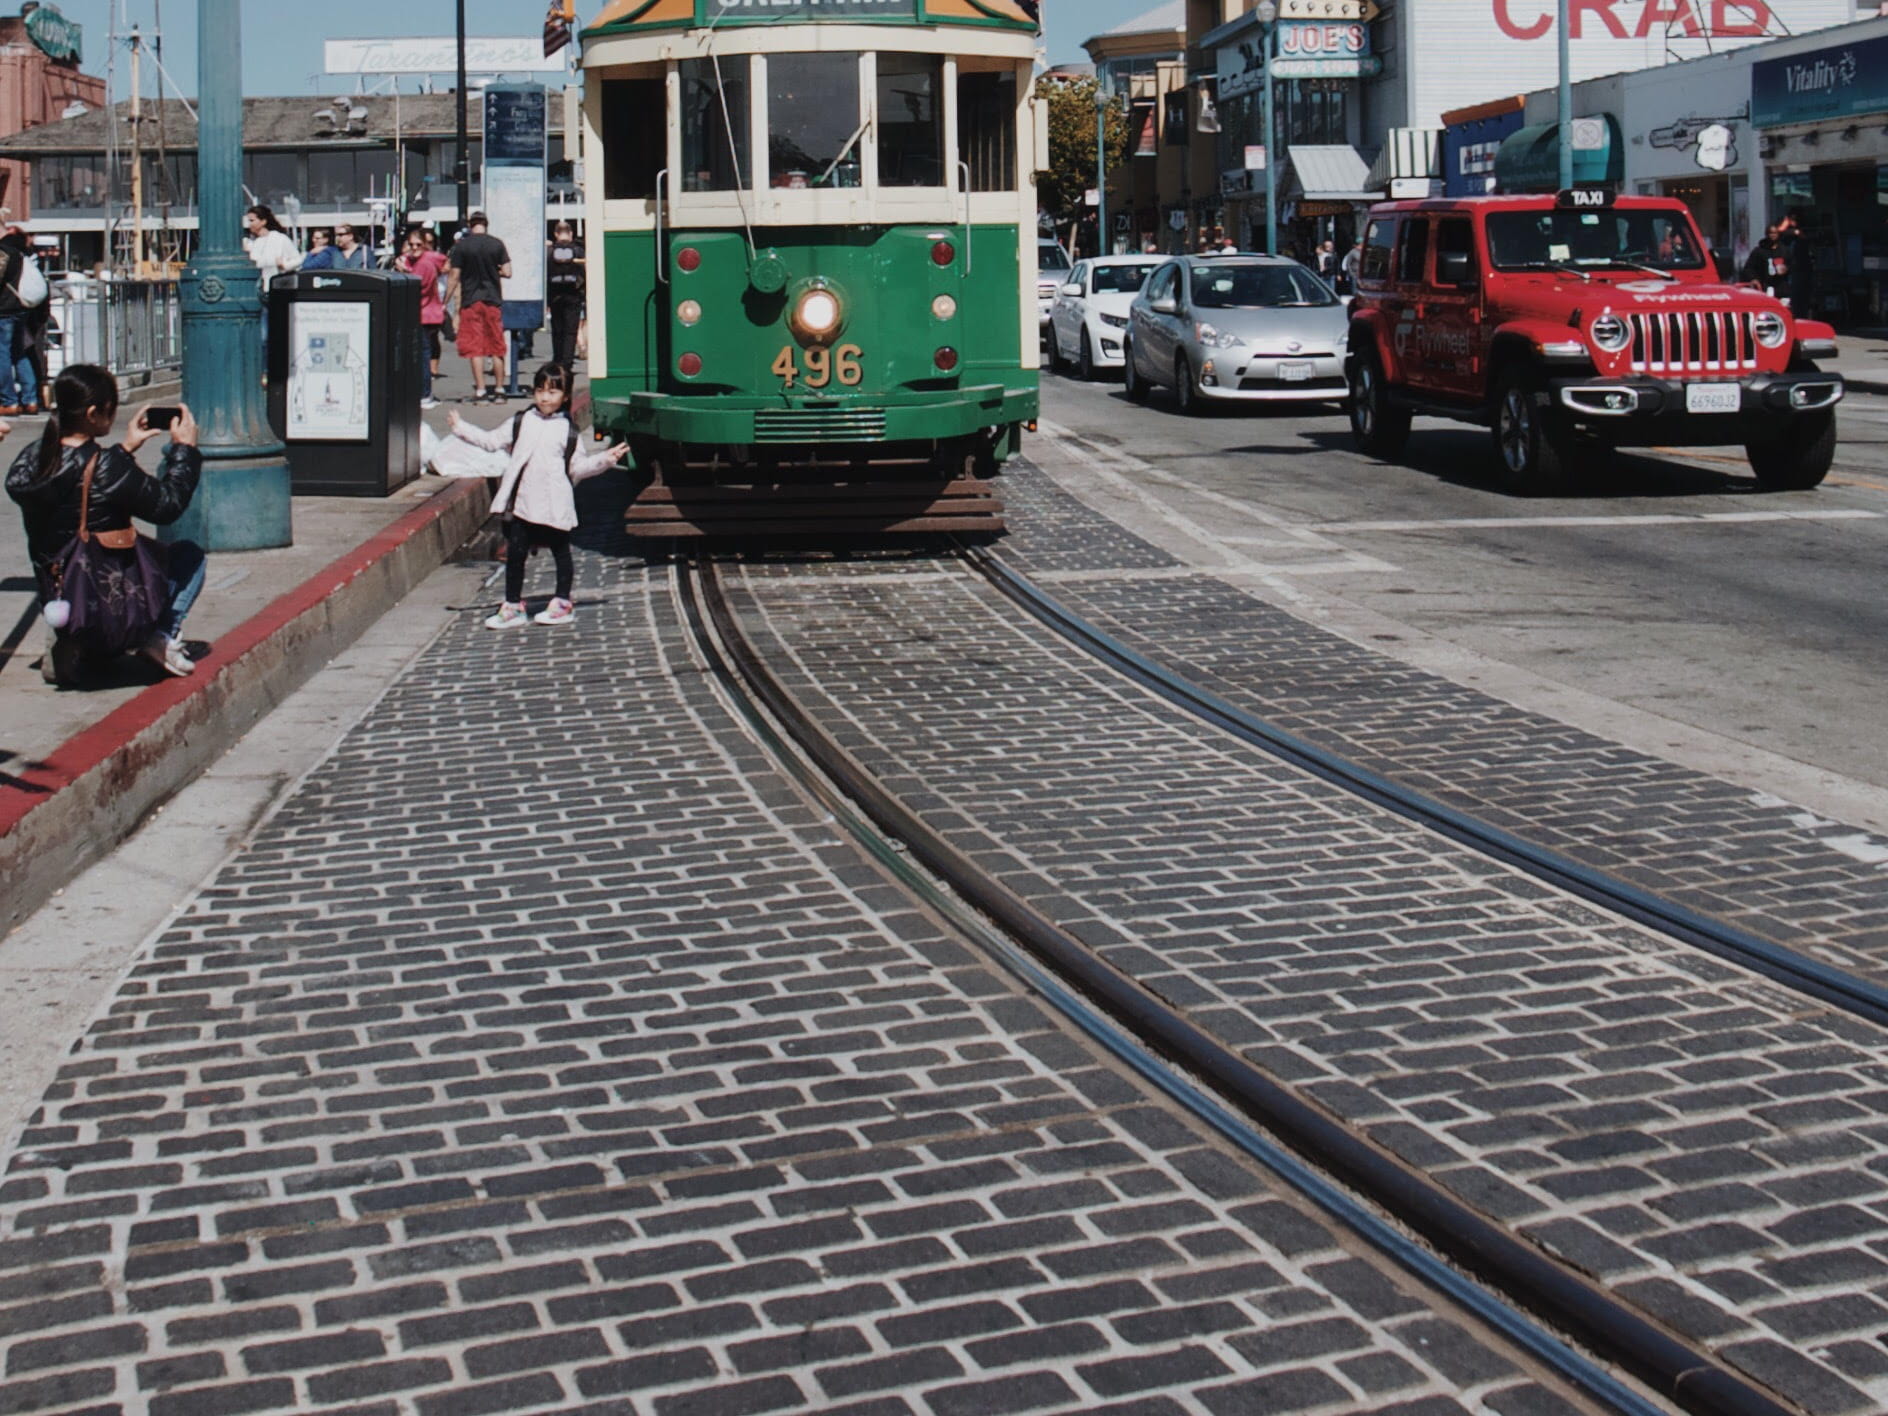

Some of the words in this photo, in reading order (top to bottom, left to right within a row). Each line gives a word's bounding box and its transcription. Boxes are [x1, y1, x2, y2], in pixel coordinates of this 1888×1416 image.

[1283, 24, 1365, 53] JOE'S
[1786, 59, 1838, 95] Vitality
[1571, 190, 1604, 206] TAXI
[1633, 292, 1732, 303] Flywheel
[1415, 325, 1471, 358] Flywheel
[770, 343, 864, 388] 496
